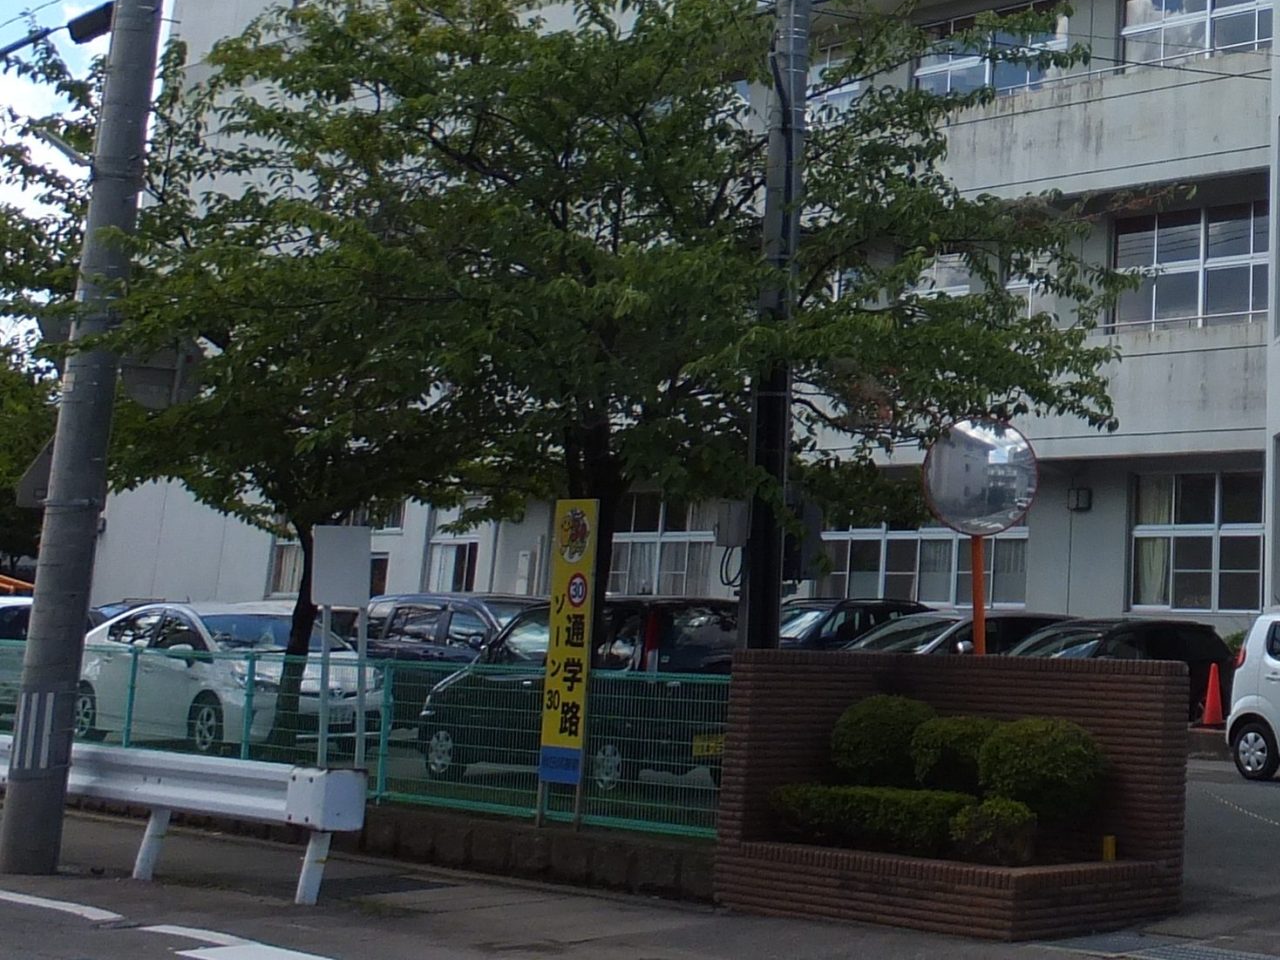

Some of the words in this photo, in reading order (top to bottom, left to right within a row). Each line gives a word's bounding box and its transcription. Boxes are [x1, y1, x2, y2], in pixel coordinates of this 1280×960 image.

[571, 582, 584, 599] 30
[559, 614, 585, 738] 通学路
